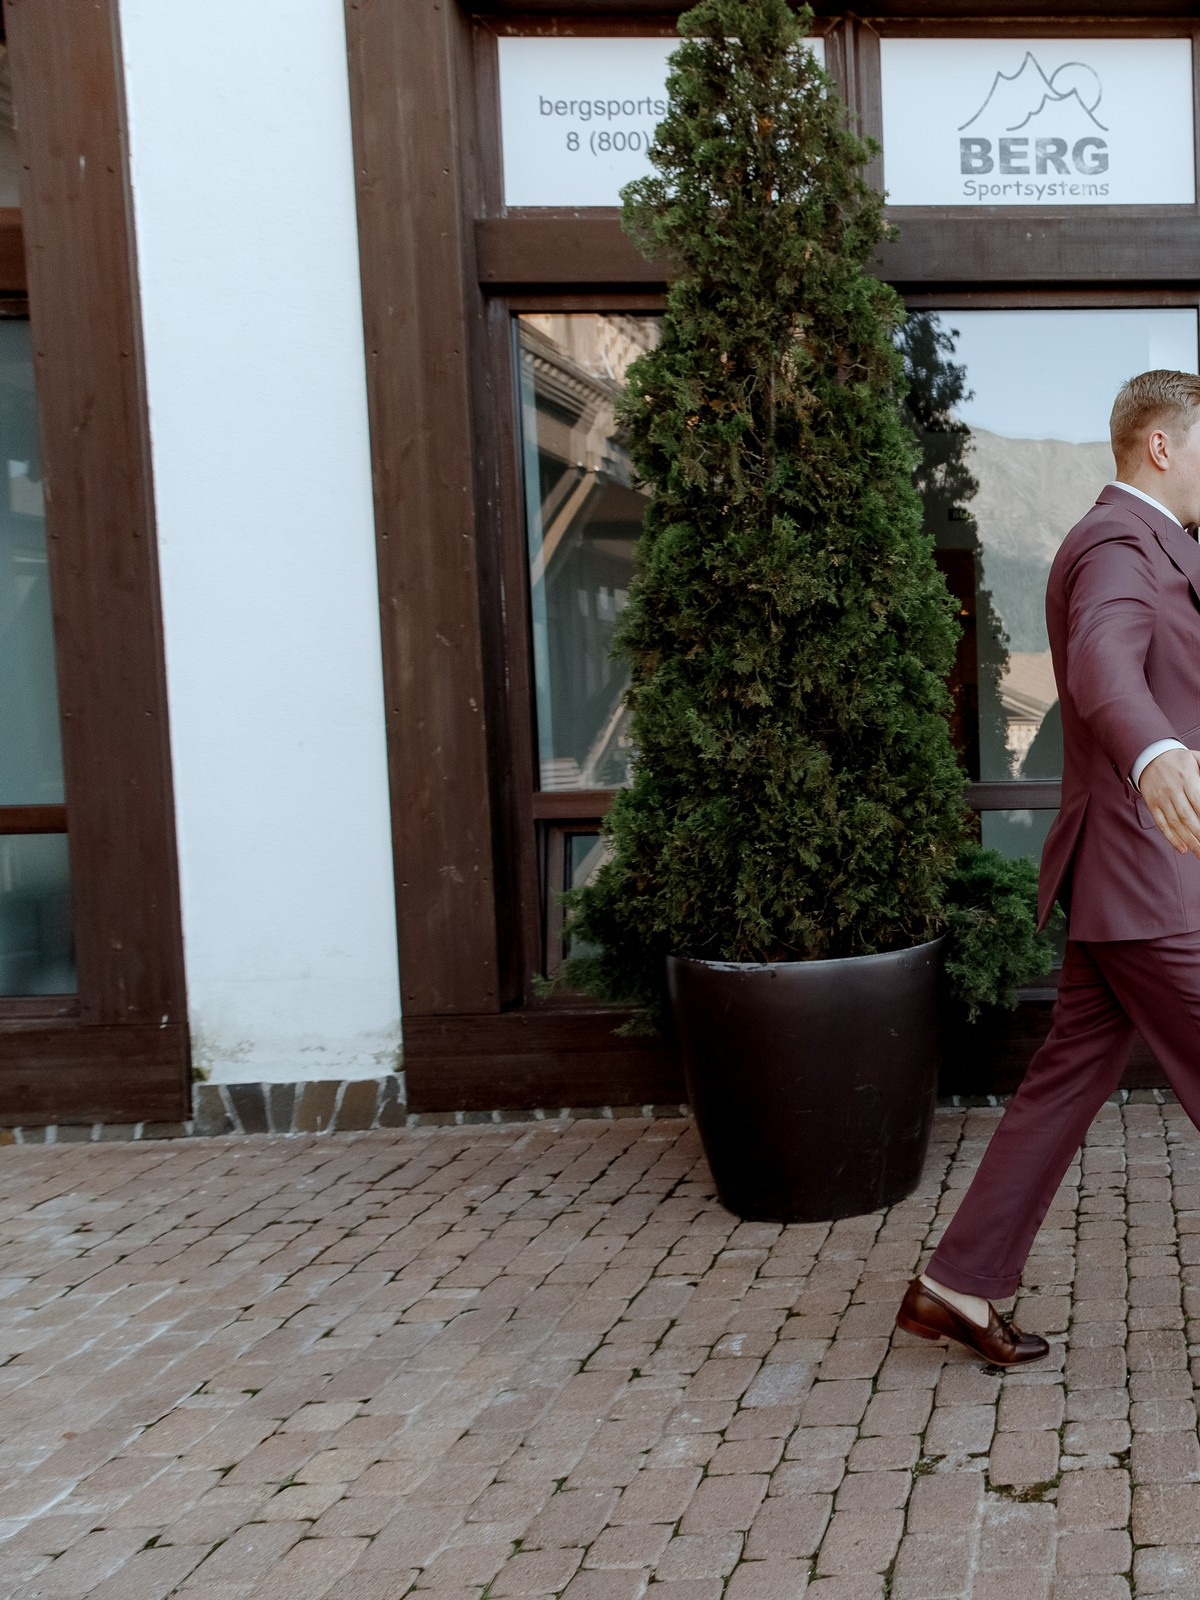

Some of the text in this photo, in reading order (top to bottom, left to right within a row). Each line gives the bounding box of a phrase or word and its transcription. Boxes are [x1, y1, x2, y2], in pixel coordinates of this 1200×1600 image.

[539, 95, 670, 121] bergsports
[566, 130, 650, 157] 8 (800)
[959, 137, 1109, 175] BERG
[963, 180, 1110, 200] Sportsystems
